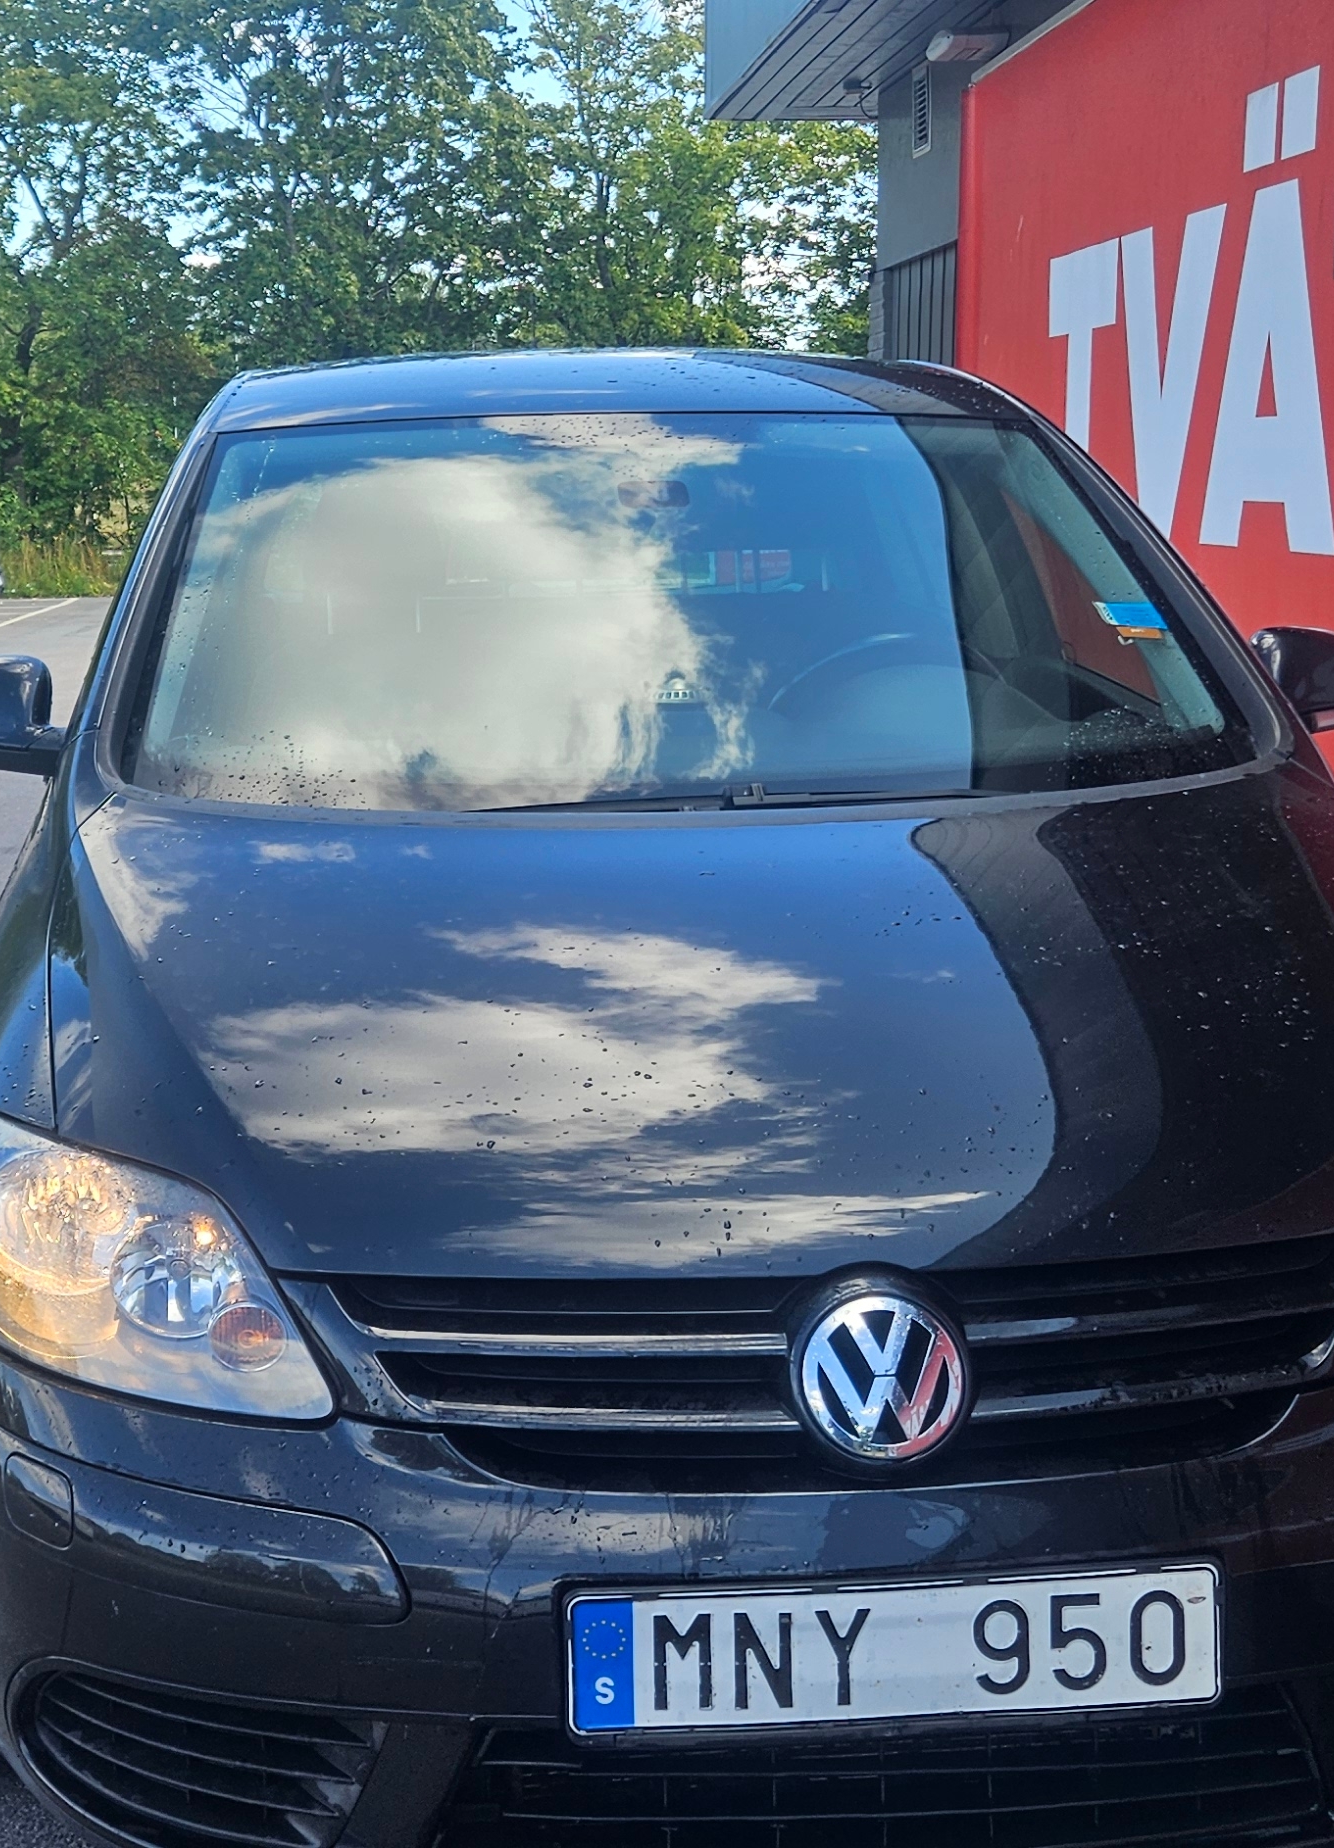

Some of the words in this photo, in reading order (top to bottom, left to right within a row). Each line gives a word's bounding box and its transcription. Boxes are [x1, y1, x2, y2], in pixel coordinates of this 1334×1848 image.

[805, 1298, 961, 1458] VW
[595, 1677, 615, 1706] S
[653, 1608, 871, 1711] MNY
[973, 1589, 1186, 1695] 950
